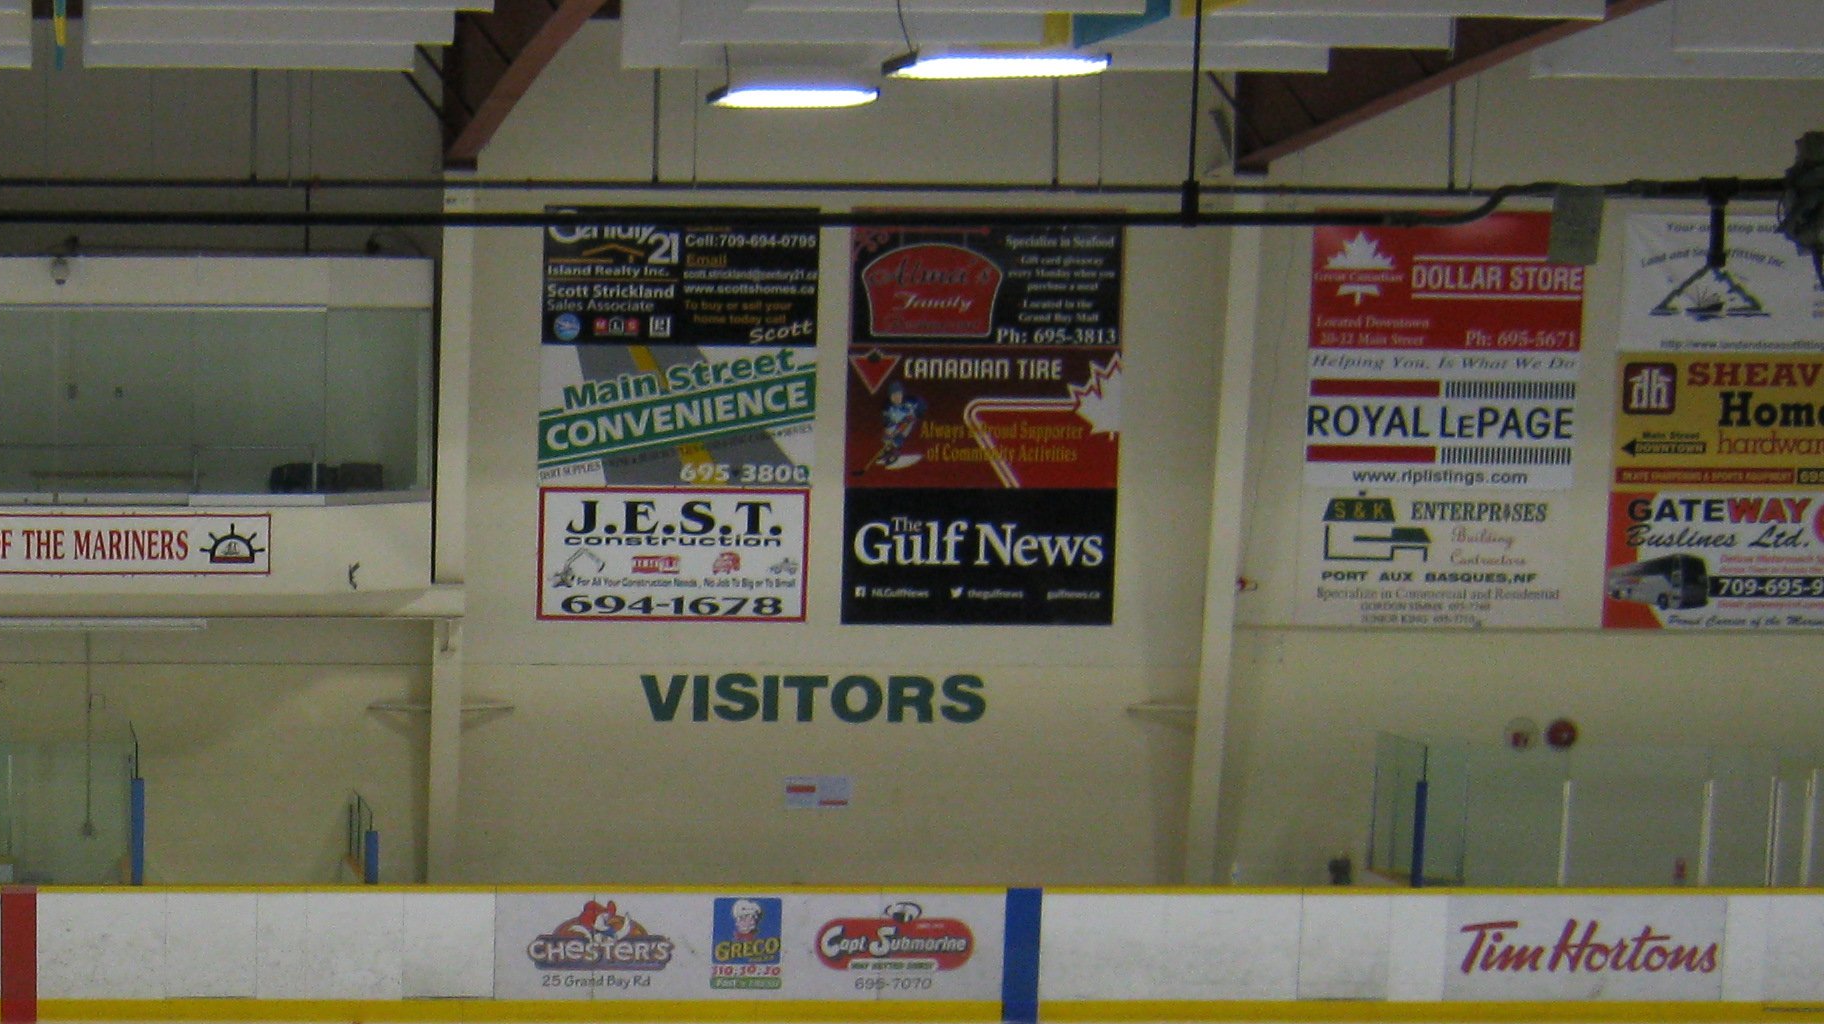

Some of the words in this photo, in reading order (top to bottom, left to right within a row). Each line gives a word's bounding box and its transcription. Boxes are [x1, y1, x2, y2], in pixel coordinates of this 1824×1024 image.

[646, 231, 680, 264] 21
[1073, 236, 1115, 248] Seafood
[1039, 256, 1062, 266] card
[547, 265, 592, 276] Island
[595, 265, 641, 278] Realty
[1034, 269, 1072, 281] Monday
[1349, 272, 1404, 282] Canadian
[1411, 265, 1503, 290] DOLLAR
[1510, 266, 1584, 291] STORE
[547, 285, 588, 299] Scott
[592, 284, 675, 299] Strickland
[547, 300, 584, 312] Sales
[587, 300, 655, 312] Associate
[701, 301, 723, 313] buy
[766, 303, 792, 313] your
[894, 293, 972, 312] Family
[1023, 299, 1061, 309] Located
[1077, 299, 1094, 309] the
[693, 313, 725, 325] home
[728, 313, 761, 327] today
[764, 313, 787, 324] call
[1018, 312, 1051, 323] Grand
[1077, 312, 1099, 322] Mall
[1316, 316, 1362, 328] Located
[1365, 316, 1430, 328] Downtown
[750, 320, 814, 344] Scott
[996, 328, 1028, 344] Ph:
[1033, 328, 1117, 345] 695-3813
[1359, 333, 1386, 346] Main
[1388, 333, 1425, 346] Street
[1465, 331, 1492, 347] Ph:
[1497, 331, 1575, 348] 695-5671
[904, 358, 1010, 380] CANADIAN
[1018, 359, 1062, 379] TIRE
[1311, 355, 1384, 371] Helping
[1437, 357, 1454, 369] Is
[1461, 357, 1507, 370] What
[1515, 357, 1544, 370] We
[563, 372, 659, 411] Main
[666, 348, 796, 392] Street
[545, 381, 810, 450] CONVENIENCE
[1307, 404, 1430, 438] ROYAL
[920, 425, 965, 443] Always
[1018, 425, 1084, 443] Supporter
[927, 446, 939, 461] of
[1018, 446, 1077, 461] Activities
[1352, 469, 1528, 486] www.rlplistings.com
[565, 500, 783, 535] J.E.S.T.
[1334, 502, 1346, 519] S
[1353, 502, 1364, 518] &
[1410, 501, 1549, 521] ENTERPRISES
[1628, 498, 1813, 524] GATEWAY
[892, 516, 924, 533] The
[564, 535, 783, 547] construction
[853, 520, 969, 566] Gulf
[974, 523, 1104, 567] News
[1450, 526, 1516, 548] Building
[1626, 523, 1738, 549] Buslines
[1748, 524, 1810, 549] Ltd.
[22, 529, 65, 560] THE
[74, 529, 189, 561] MARINERS
[1450, 549, 1526, 568] Contractors
[576, 577, 590, 586] For
[591, 577, 602, 586] All
[602, 577, 622, 586] Your
[622, 577, 671, 587] Construction
[1322, 571, 1368, 582] PORT
[1379, 571, 1414, 582] AUX
[1316, 587, 1377, 601] Specialize
[1380, 588, 1392, 599] in
[1395, 588, 1468, 600] Commercial
[1470, 588, 1491, 600] and
[1494, 588, 1560, 601] Residential
[561, 595, 784, 616] 694-1678
[640, 672, 987, 723] VISITORS
[715, 937, 781, 962] GRECO
[821, 925, 868, 958] Capt
[868, 926, 967, 957] Submarine
[1460, 919, 1545, 975] Tim
[1546, 919, 1721, 974] Hortons
[542, 976, 561, 987] 25
[564, 975, 604, 987] Grand
[606, 976, 631, 990] Bay
[633, 976, 651, 987] Rd
